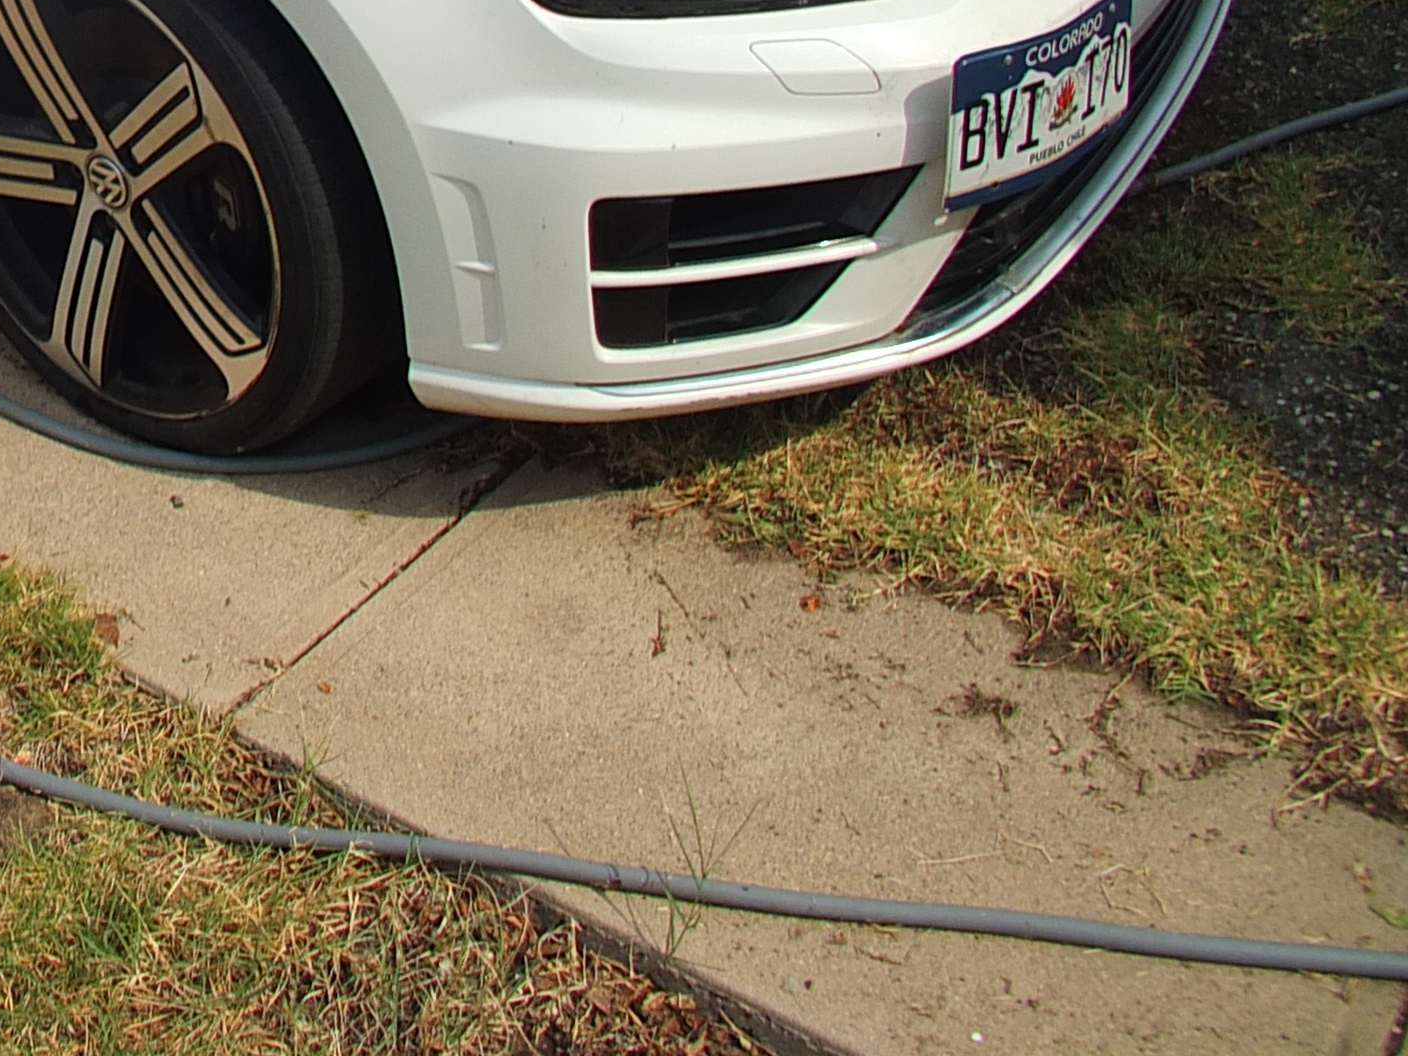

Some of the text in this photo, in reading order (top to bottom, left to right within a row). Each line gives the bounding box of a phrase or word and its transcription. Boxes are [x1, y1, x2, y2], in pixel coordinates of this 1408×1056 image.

[1025, 11, 1103, 67] COLORADO
[960, 28, 1127, 171] BVI I70
[1029, 140, 1064, 165] PUEBLO
